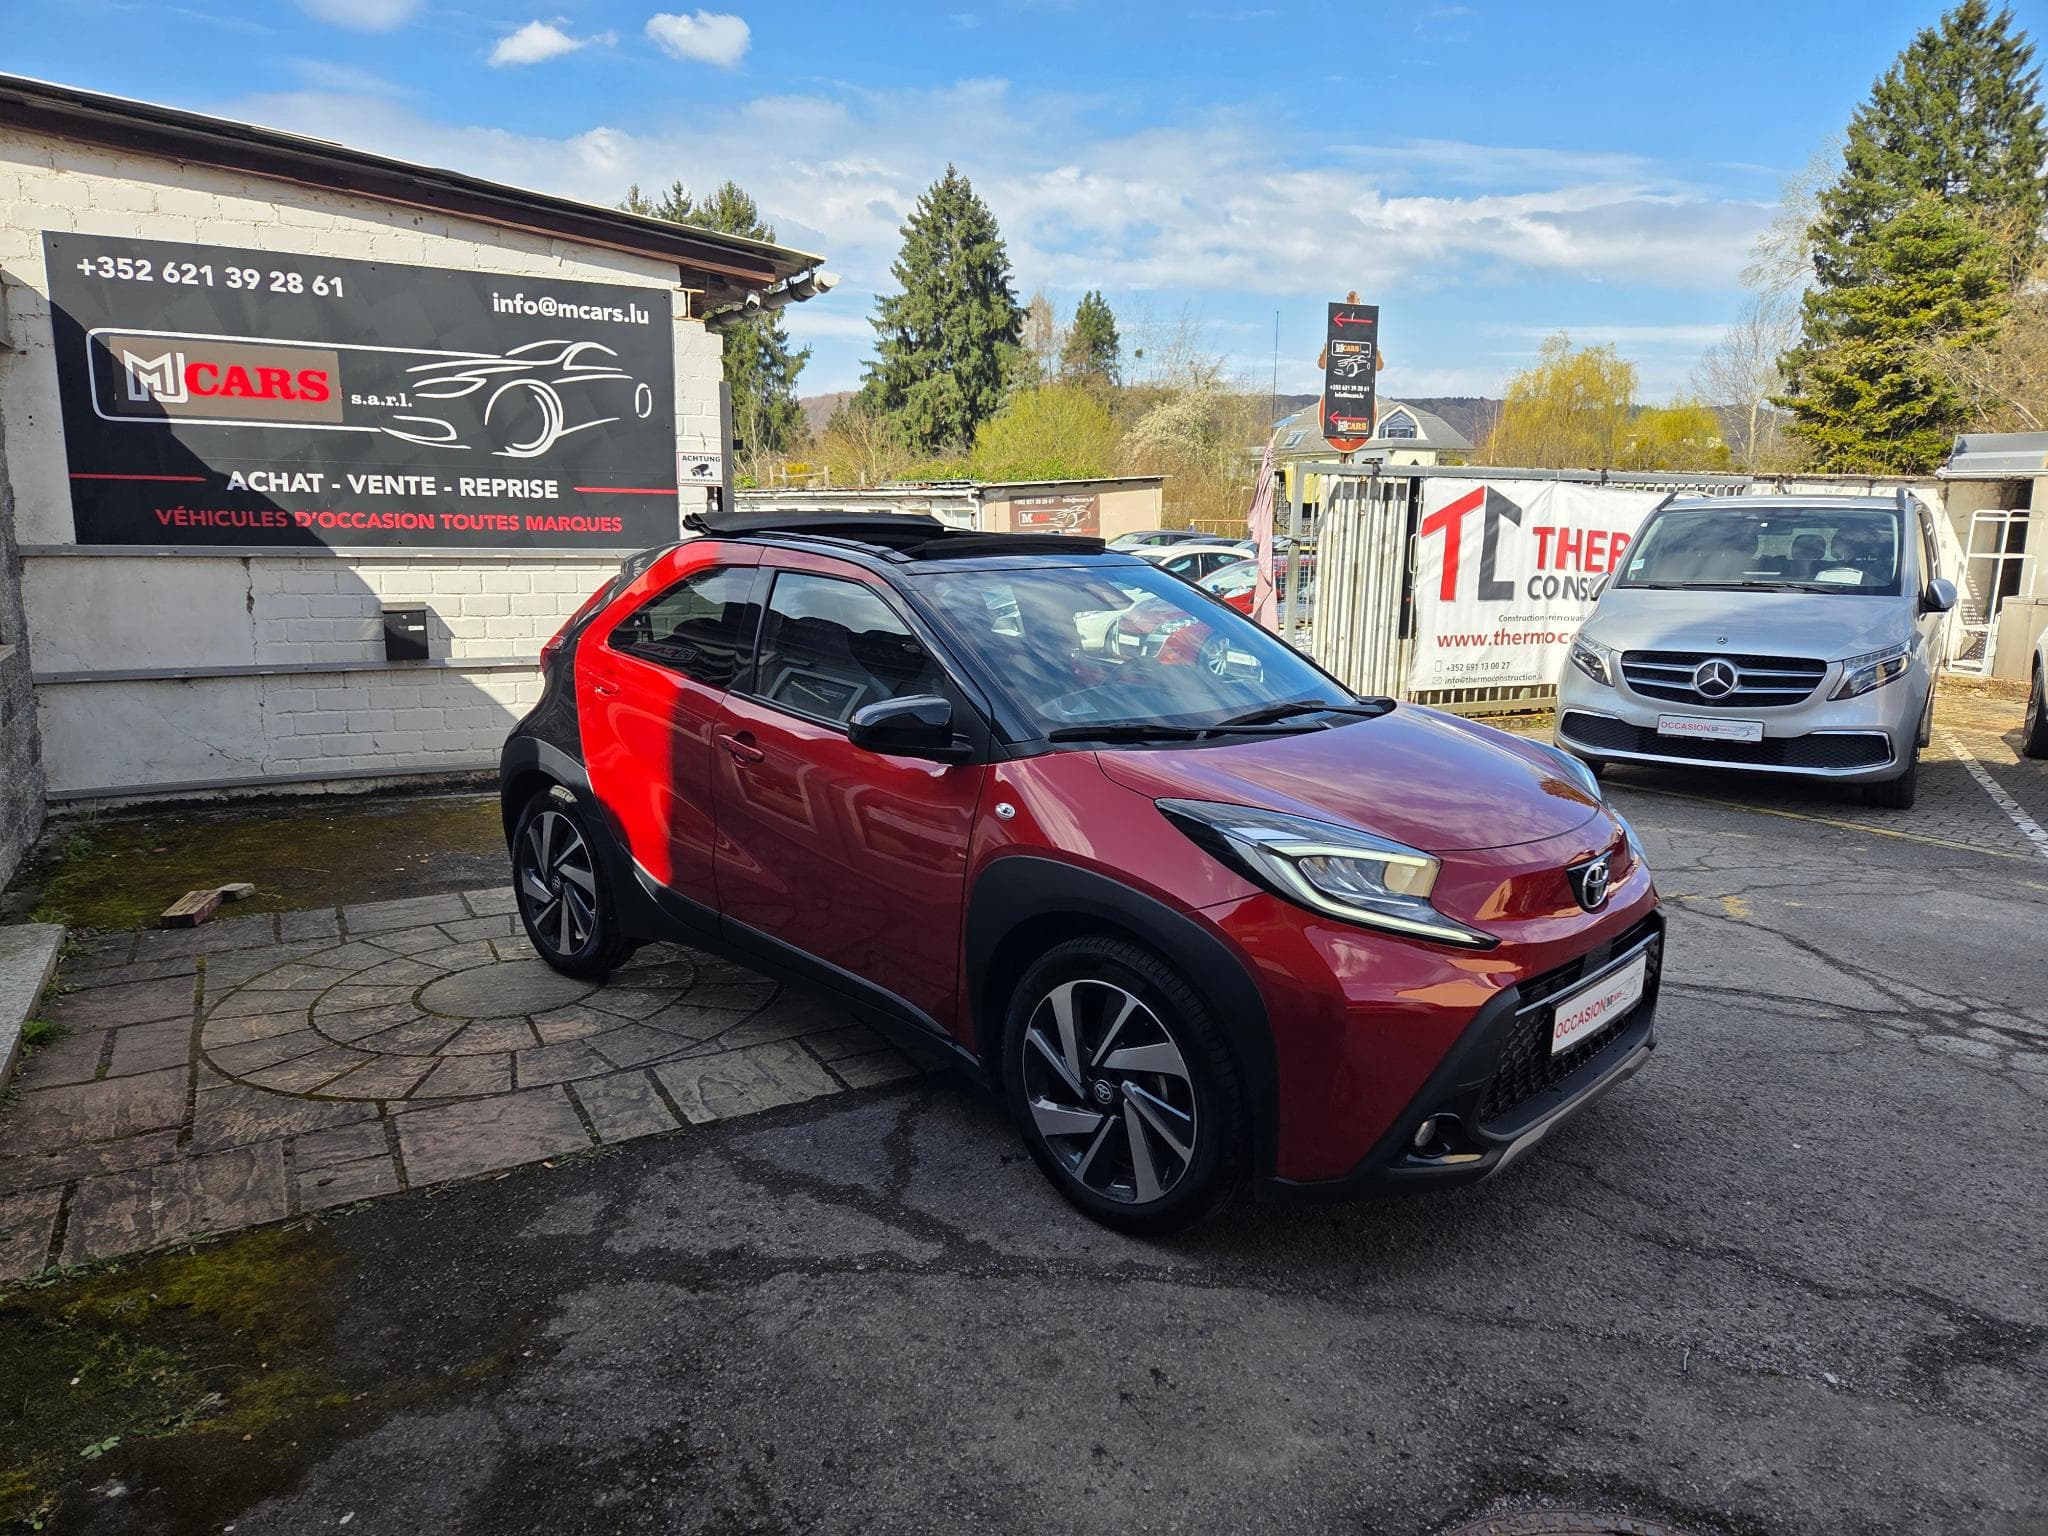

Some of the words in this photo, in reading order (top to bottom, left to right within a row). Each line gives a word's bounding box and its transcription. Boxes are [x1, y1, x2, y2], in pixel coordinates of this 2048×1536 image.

[76, 256, 153, 281] +352
[162, 262, 214, 287] 621
[224, 267, 260, 290] 39
[269, 271, 304, 294] 28
[312, 275, 344, 298] 61
[492, 292, 649, 324] info@mcars.lu
[351, 392, 413, 408] s.a.r.l.
[682, 455, 721, 463] ACHTUNG
[226, 470, 324, 493] ACHAT
[347, 474, 437, 496] VENTE
[459, 477, 559, 499] REPRISE
[155, 506, 288, 528] VÉHICULES
[294, 511, 435, 530] D'OCCASION
[440, 513, 520, 531] TOUTES
[525, 515, 623, 533] MARQUES
[1527, 575, 1592, 602] CONS
[1446, 663, 1464, 672] +352
[1481, 662, 1489, 670] 13
[1501, 661, 1511, 669] 27
[1661, 721, 1711, 732] OCCASION
[1555, 998, 1606, 1039] OCCASION
